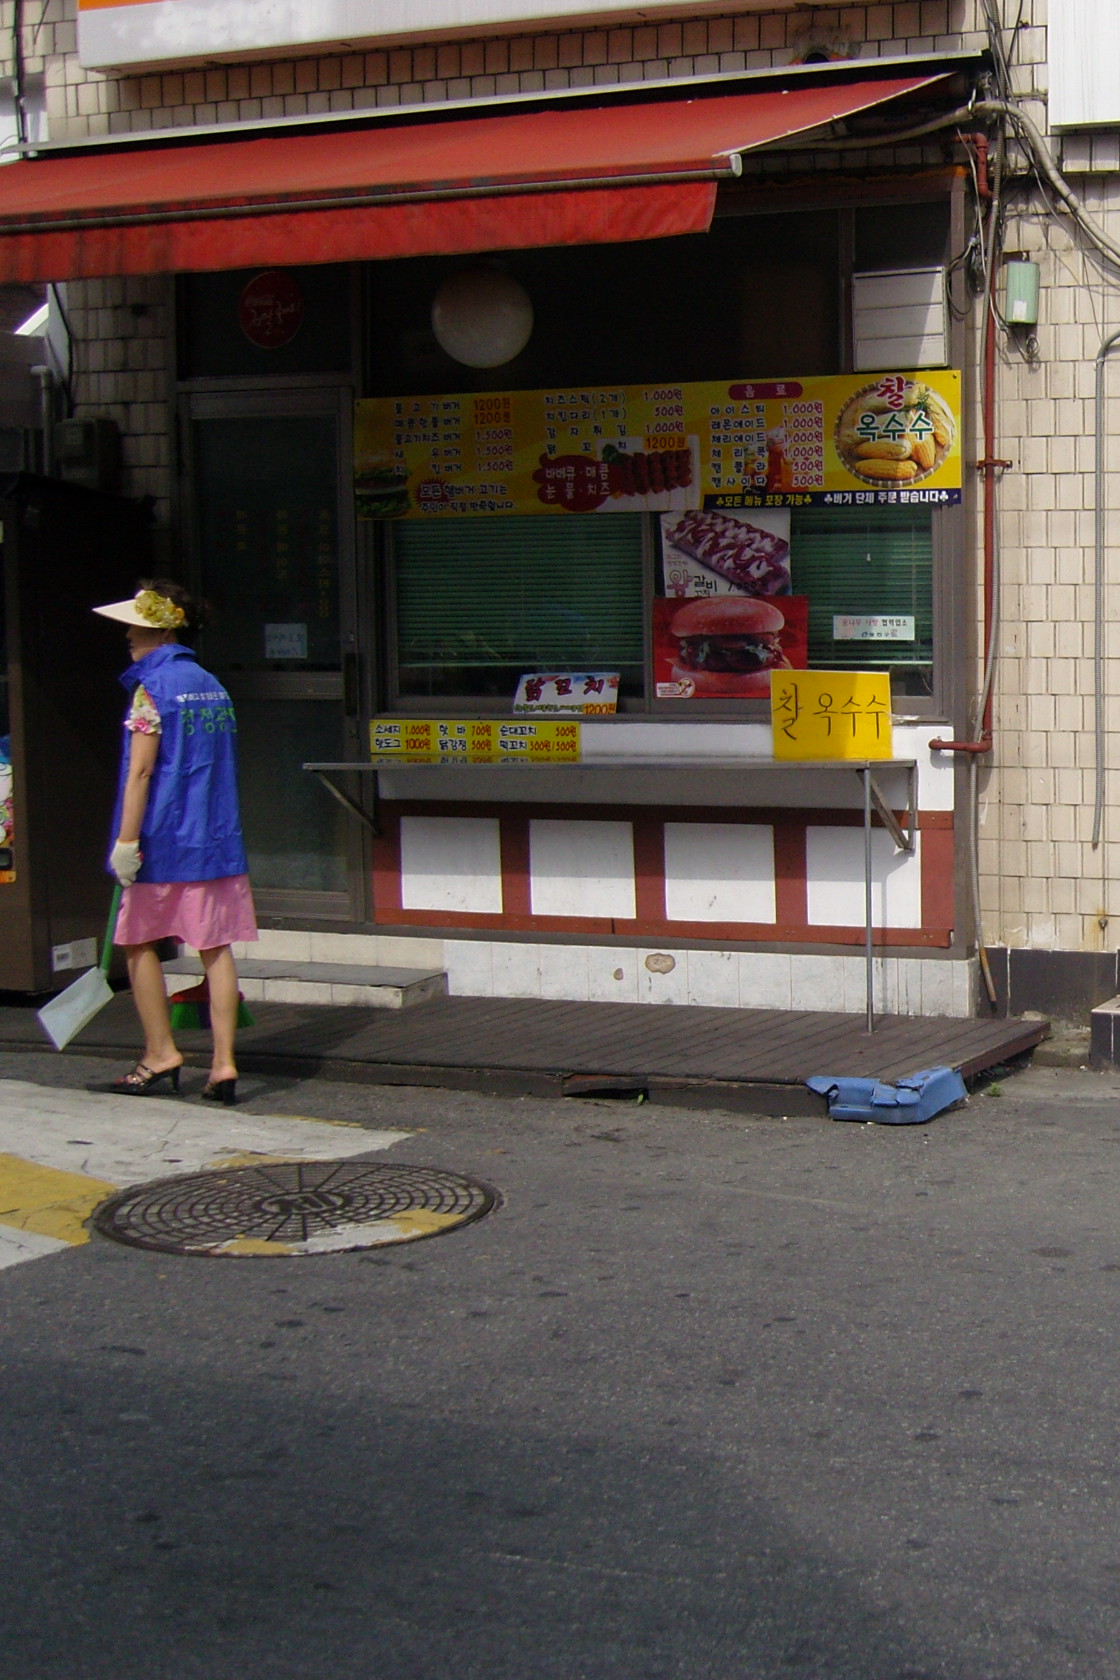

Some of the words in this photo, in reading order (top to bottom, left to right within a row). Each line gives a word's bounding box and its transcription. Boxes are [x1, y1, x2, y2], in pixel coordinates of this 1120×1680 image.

[876, 376, 905, 409] 찰
[655, 405, 683, 416] 500원
[711, 418, 766, 431] 레몬에이드
[856, 413, 933, 442] 옥수수
[646, 436, 685, 449] 1200원
[794, 459, 823, 472] 500원
[794, 473, 823, 486] 500원
[421, 485, 441, 497] 모든
[445, 484, 474, 498] 햄버거
[480, 483, 508, 495] 고기는
[834, 491, 852, 503] 버거
[900, 489, 940, 503] 받습니다
[525, 676, 604, 702] 닭꼬치
[584, 704, 616, 714] 1200원
[812, 693, 887, 740] 옥수수
[376, 725, 401, 735] 소세지
[471, 725, 492, 736] 700원
[500, 725, 537, 736] 순대꼬치
[556, 726, 576, 737] 500원
[376, 739, 401, 749] 핫도그
[440, 739, 466, 751] 닭강정
[471, 739, 492, 750] 500원
